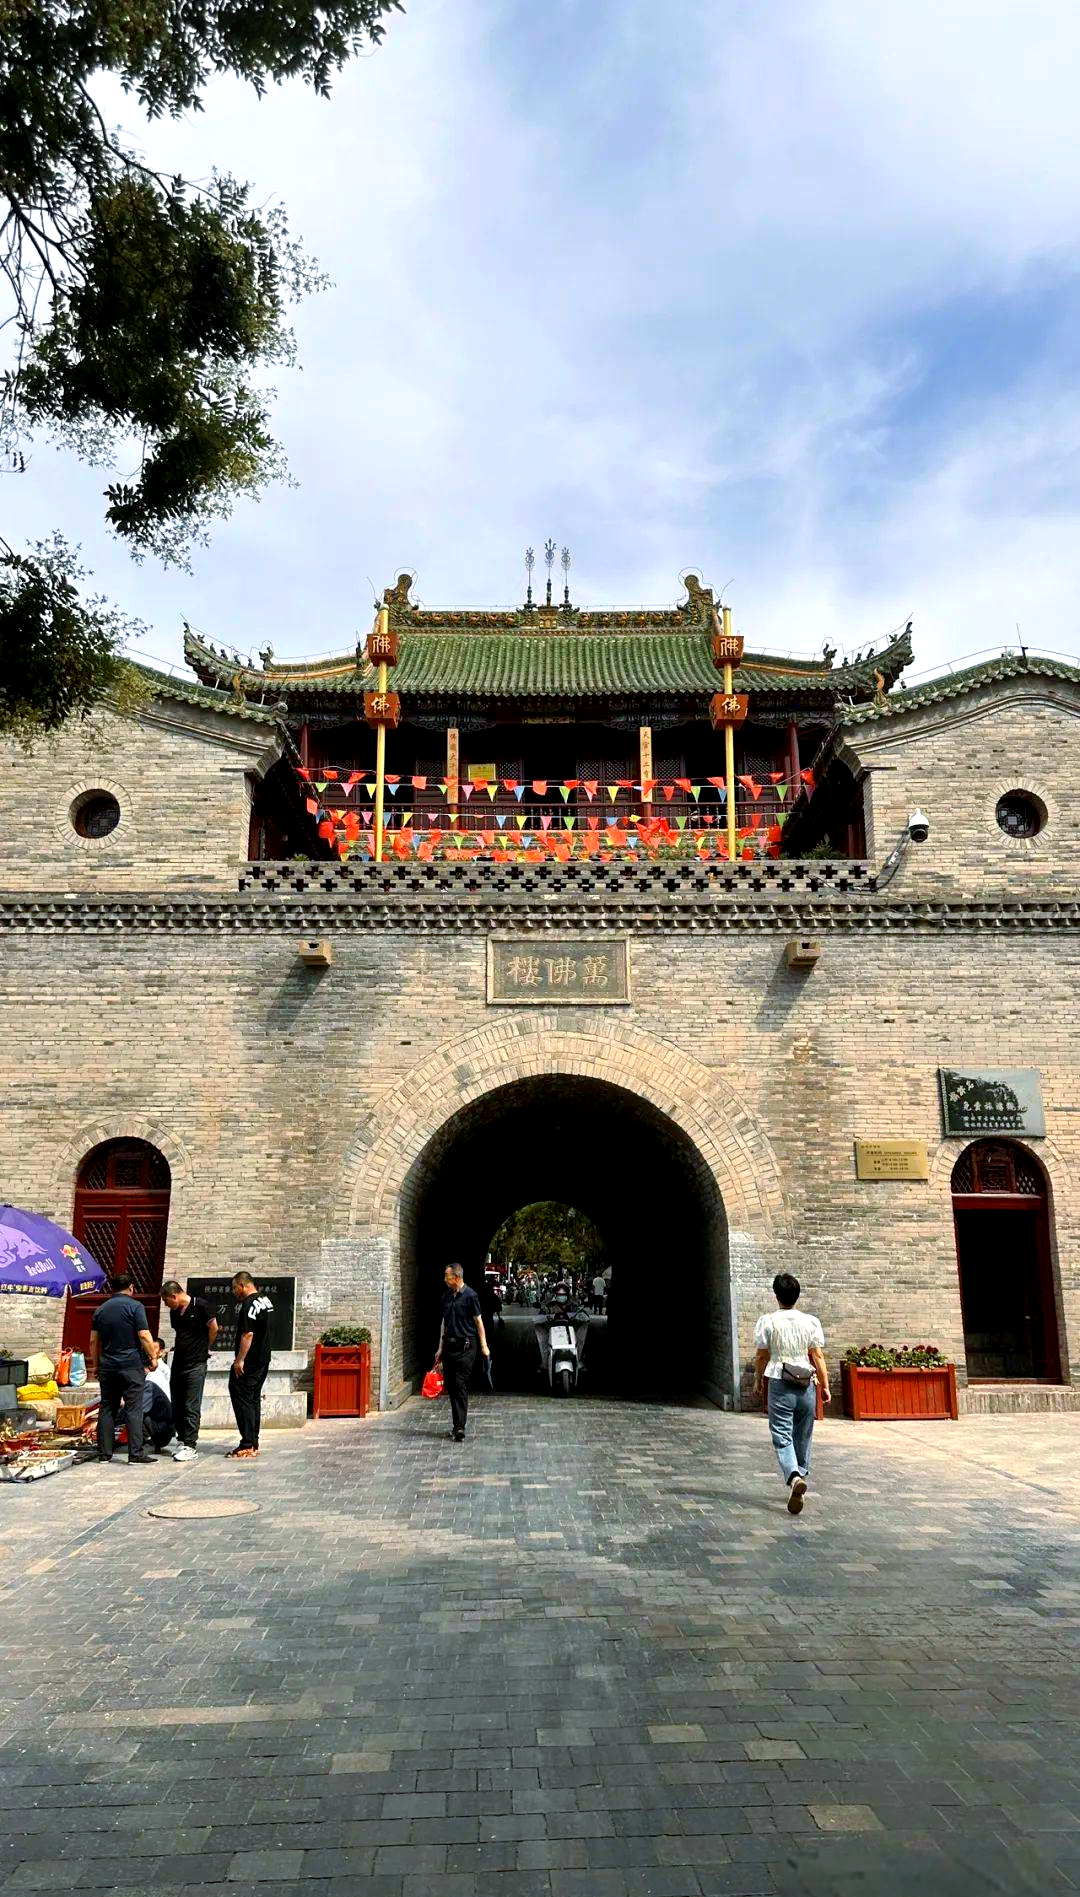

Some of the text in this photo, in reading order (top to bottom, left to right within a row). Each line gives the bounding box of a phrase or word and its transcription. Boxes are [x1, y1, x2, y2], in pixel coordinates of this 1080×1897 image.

[372, 635, 391, 654] 佛
[720, 637, 739, 656] 佛
[371, 694, 390, 716] 佛
[721, 694, 740, 716] 佛
